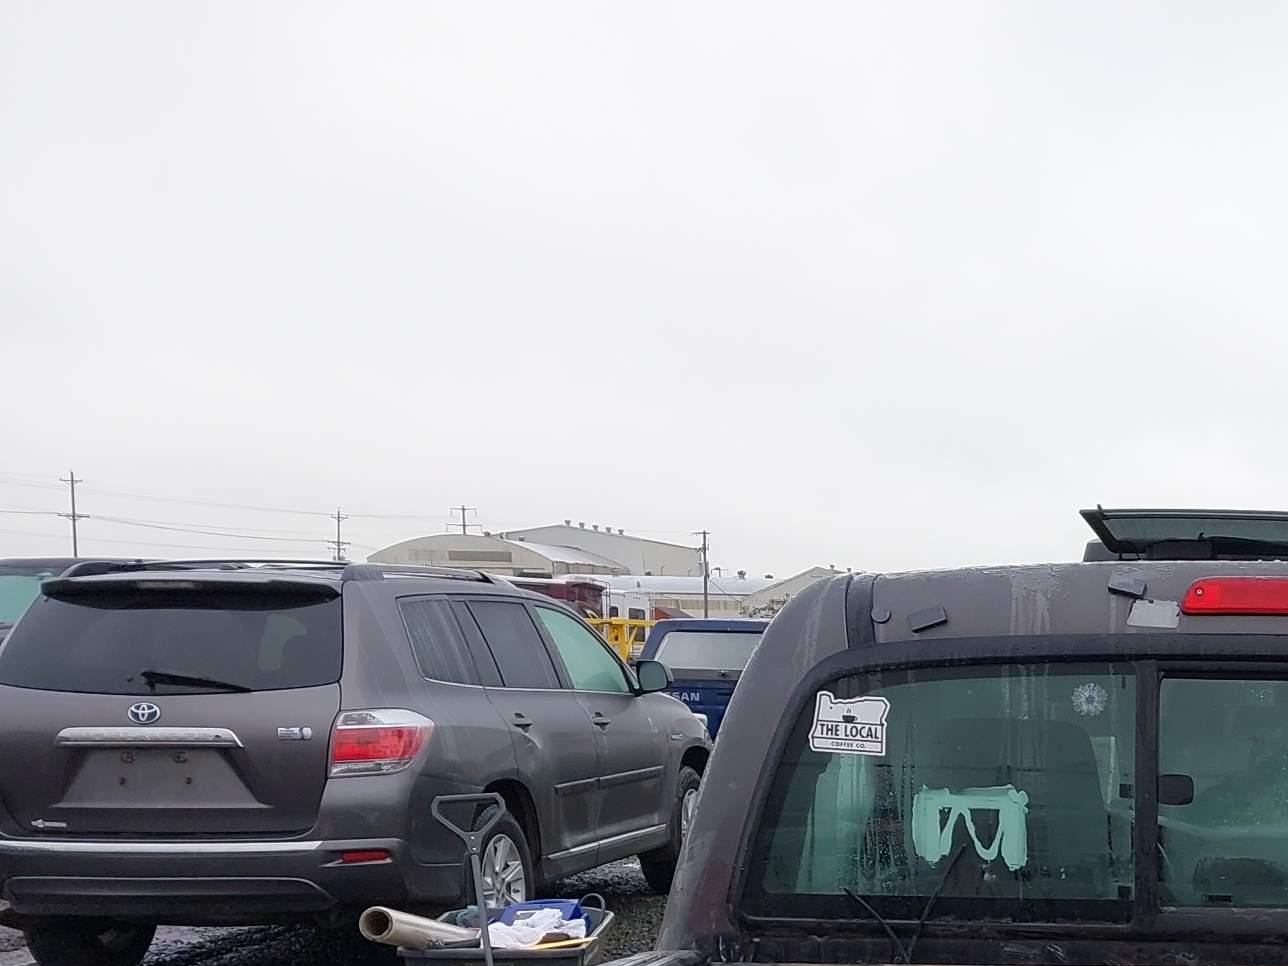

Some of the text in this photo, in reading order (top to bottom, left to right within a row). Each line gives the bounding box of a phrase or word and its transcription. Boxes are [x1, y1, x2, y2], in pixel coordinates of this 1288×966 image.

[819, 724, 880, 740] THE LOCAL
[830, 740, 854, 748] COFFEE
